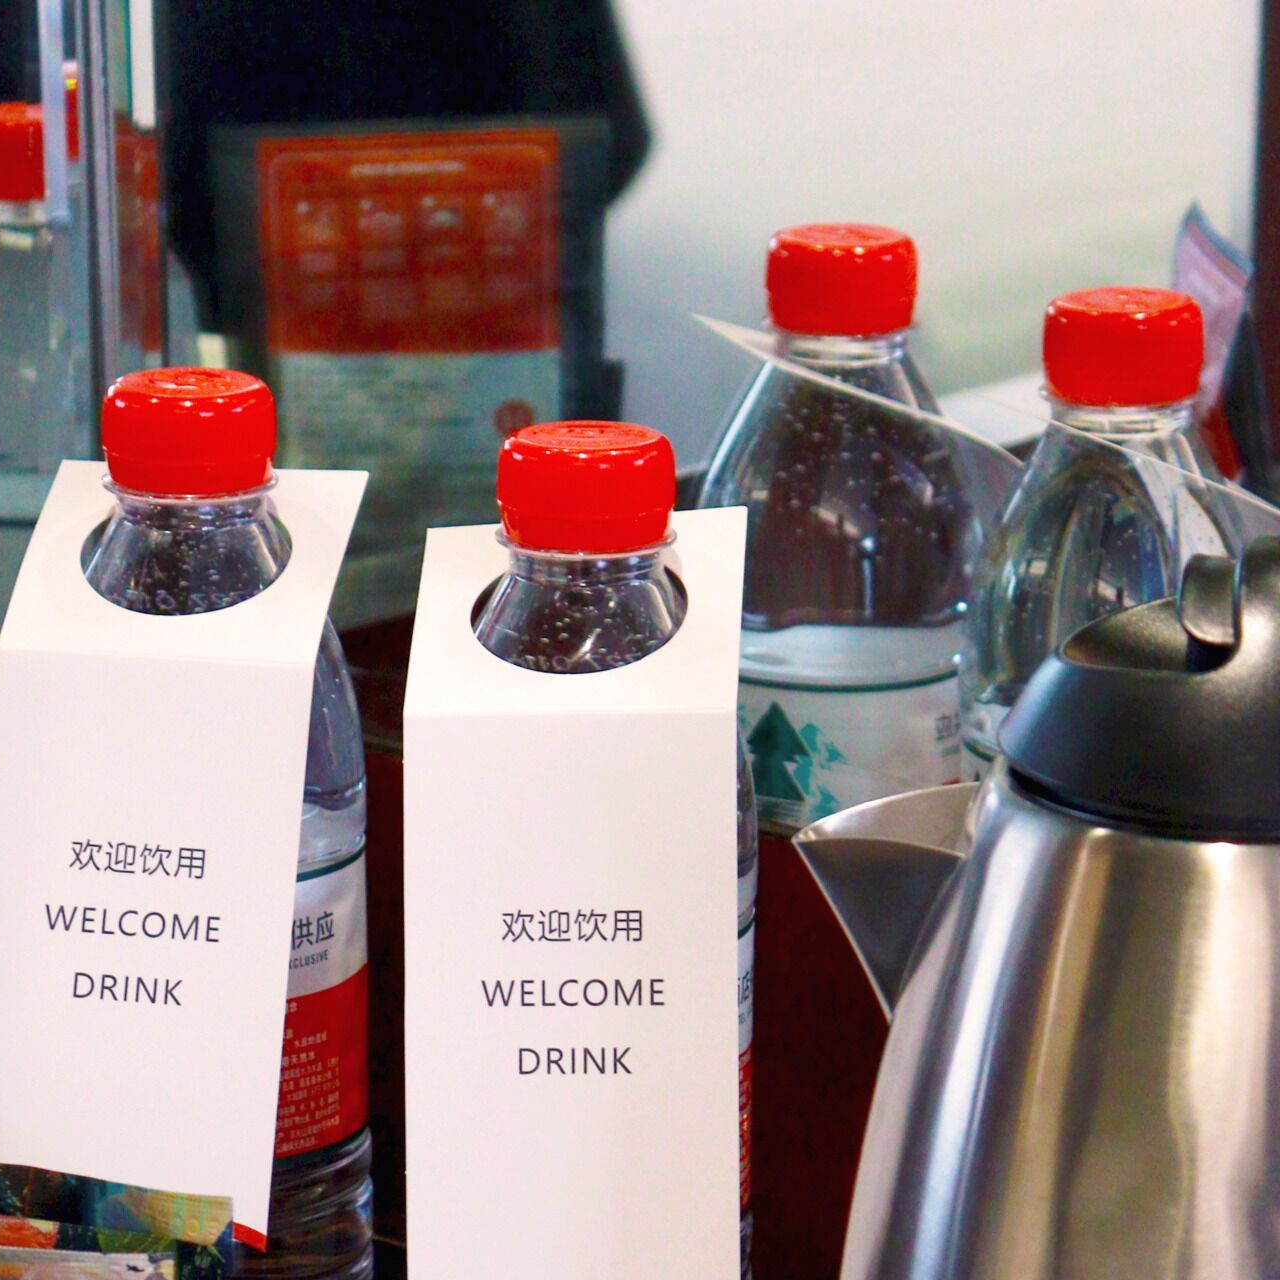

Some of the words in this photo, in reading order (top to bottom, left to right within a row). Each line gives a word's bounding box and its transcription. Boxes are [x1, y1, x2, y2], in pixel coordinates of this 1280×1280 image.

[70, 840, 206, 879] 欢迎饮用
[45, 904, 220, 943] WELCOME
[502, 909, 643, 942] 欢迎饮用
[73, 972, 183, 1006] DRINK
[482, 978, 665, 1007] WELCOME
[518, 1047, 632, 1075] DRINK
